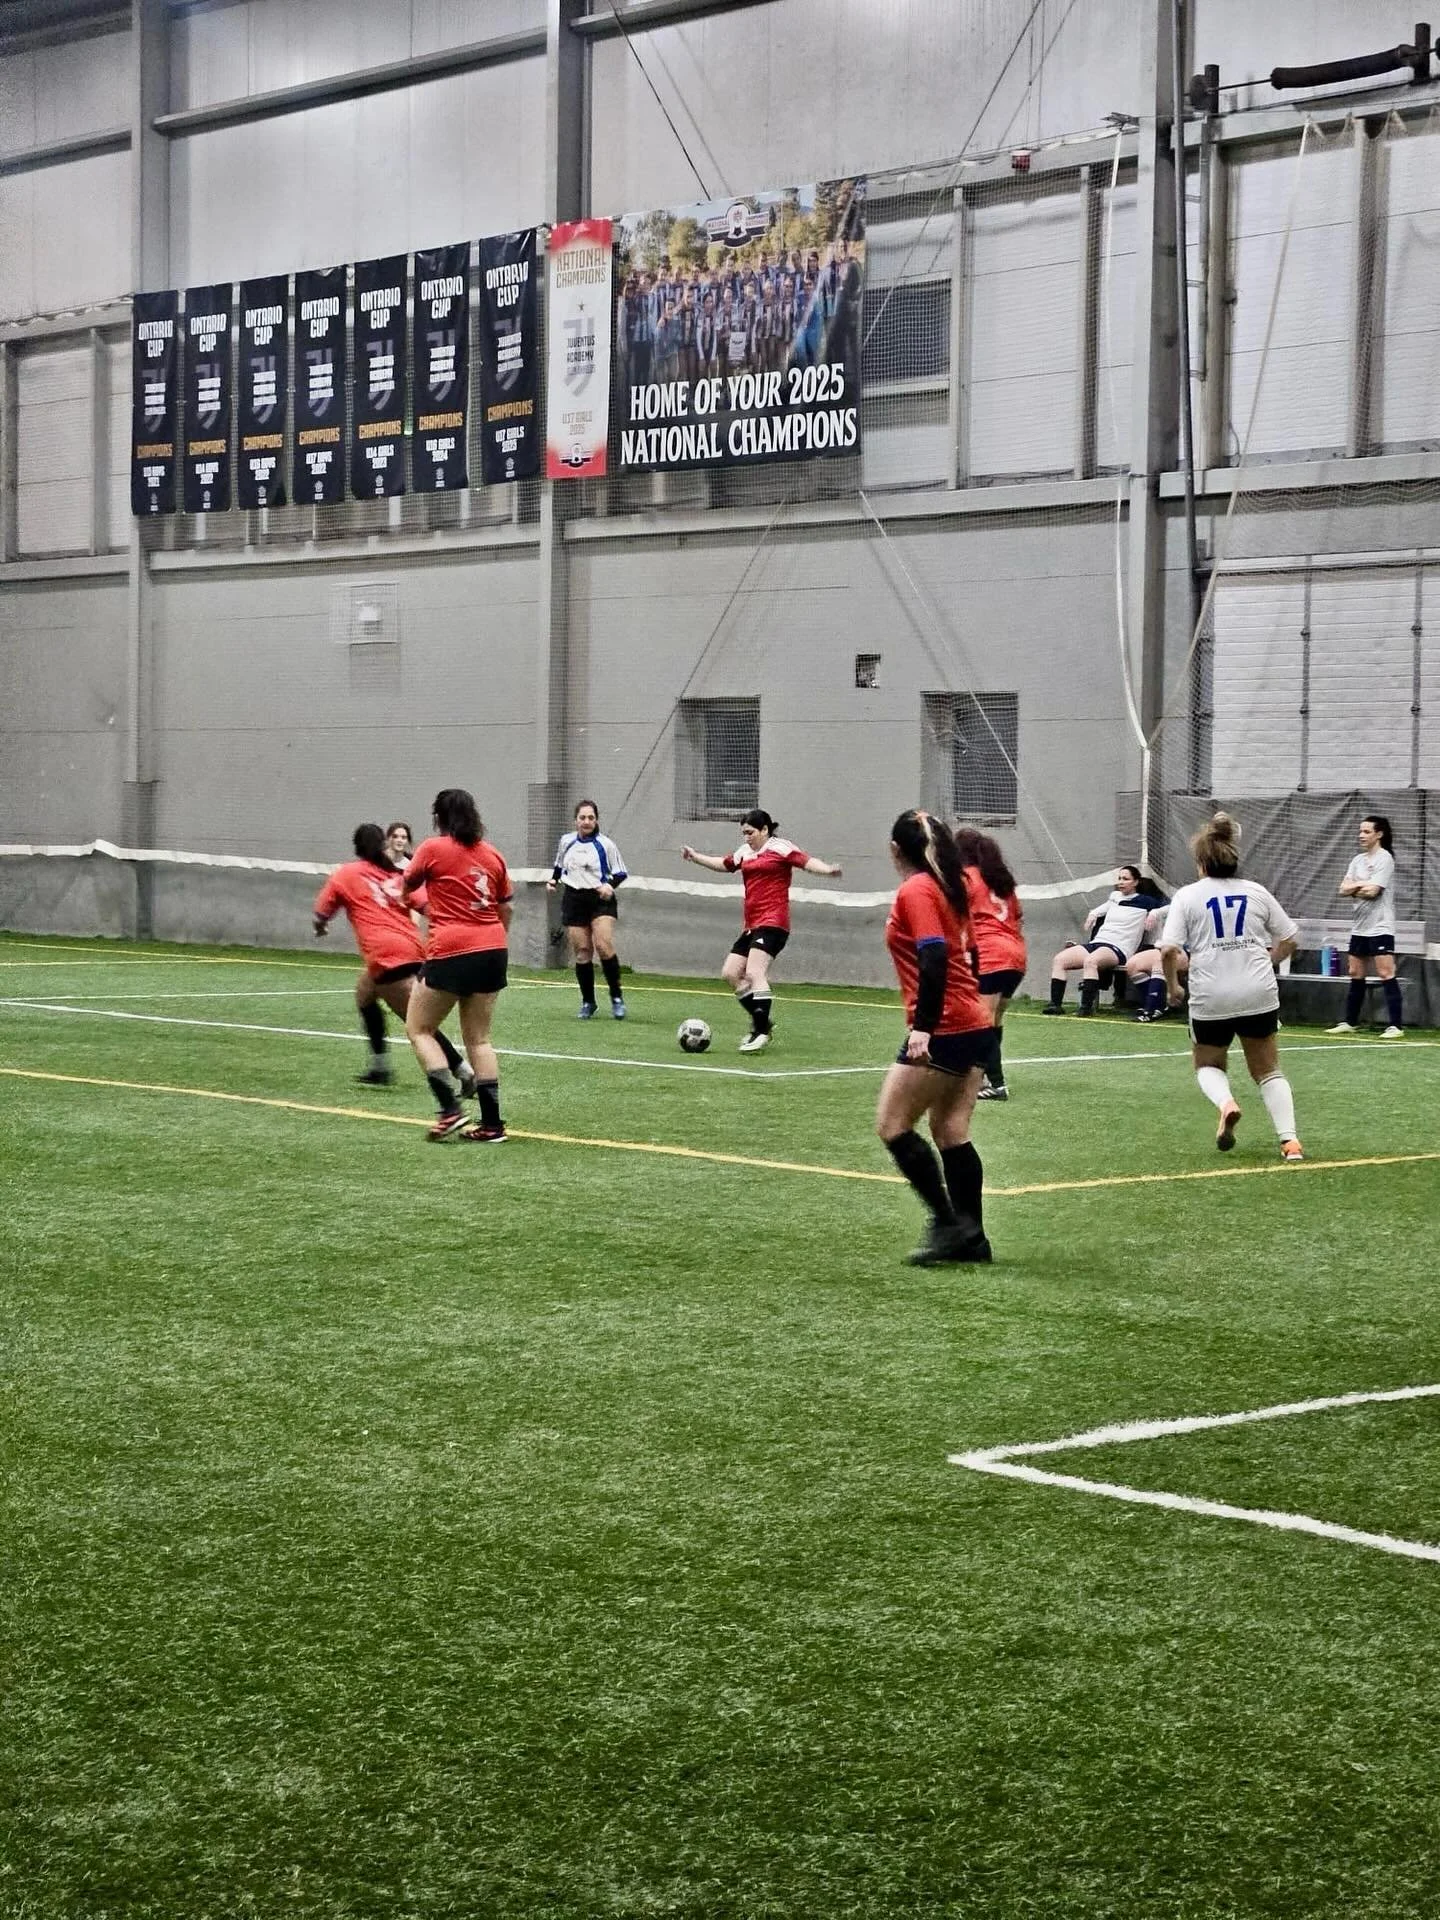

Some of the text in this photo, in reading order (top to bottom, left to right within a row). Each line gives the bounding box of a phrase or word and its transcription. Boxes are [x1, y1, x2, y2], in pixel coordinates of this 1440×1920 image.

[557, 247, 607, 273] NATIONAL
[486, 261, 529, 290] ONTARIO
[557, 266, 606, 289] CHAMPIONS
[361, 287, 401, 312] ONTARIO
[421, 276, 463, 301] ONTARIO
[497, 284, 519, 308] CUP
[245, 305, 283, 328] ONTARIO
[301, 296, 339, 320] ONTARIO
[371, 308, 390, 329] CUP
[431, 297, 451, 319] CUP
[139, 320, 173, 340] ONTARIO
[191, 313, 226, 335] ONTARIO
[310, 317, 329, 338] CUP
[200, 333, 216, 352] CUP
[254, 326, 273, 346] CUP
[148, 340, 164, 358] CUP
[630, 363, 845, 421] HOME OF YOUR 2025
[419, 411, 463, 431] CHAMPIONS
[487, 399, 533, 422] CHAMPIONS
[620, 408, 857, 465] NATIONAL CHAMPIONS
[1206, 895, 1248, 938] 17
